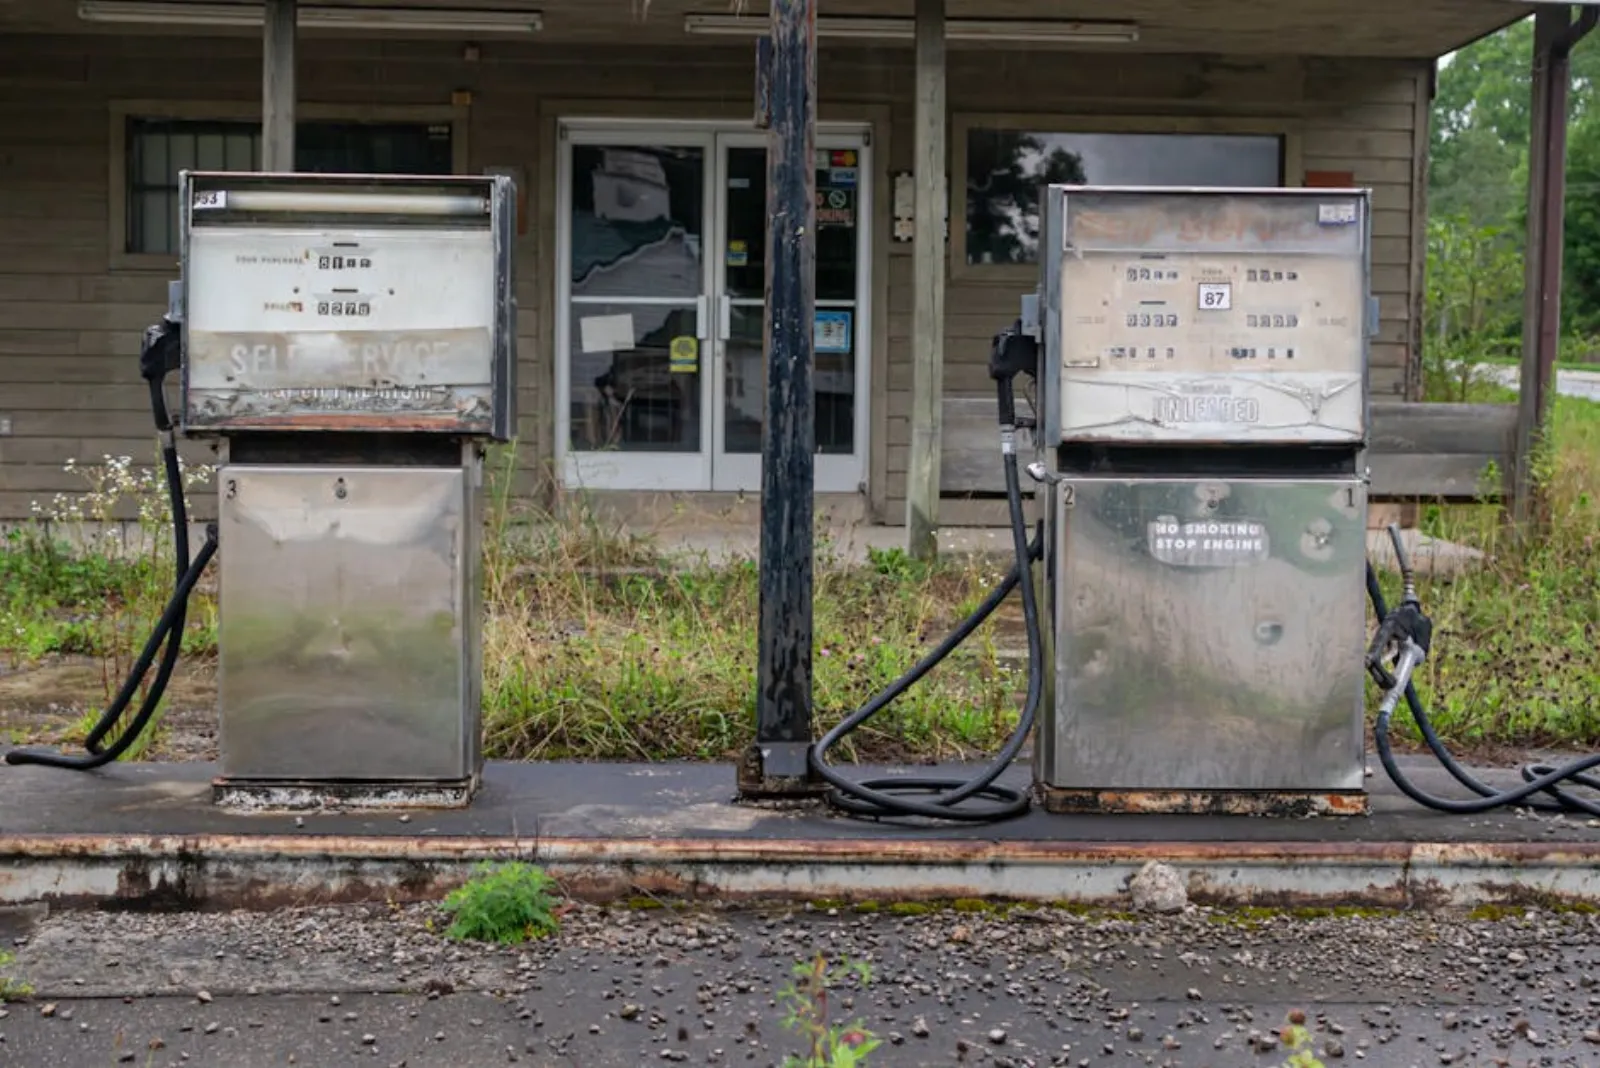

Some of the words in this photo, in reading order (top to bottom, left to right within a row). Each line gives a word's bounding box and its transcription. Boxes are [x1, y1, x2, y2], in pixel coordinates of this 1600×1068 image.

[1205, 292, 1225, 306] 87
[227, 479, 238, 499] 3
[1063, 485, 1075, 506] 2
[1345, 487, 1355, 507] 1
[1155, 523, 1180, 535] NO
[1185, 523, 1260, 536] SMOKING
[1155, 538, 1197, 550] STOP
[1203, 538, 1263, 551] ENGINE
